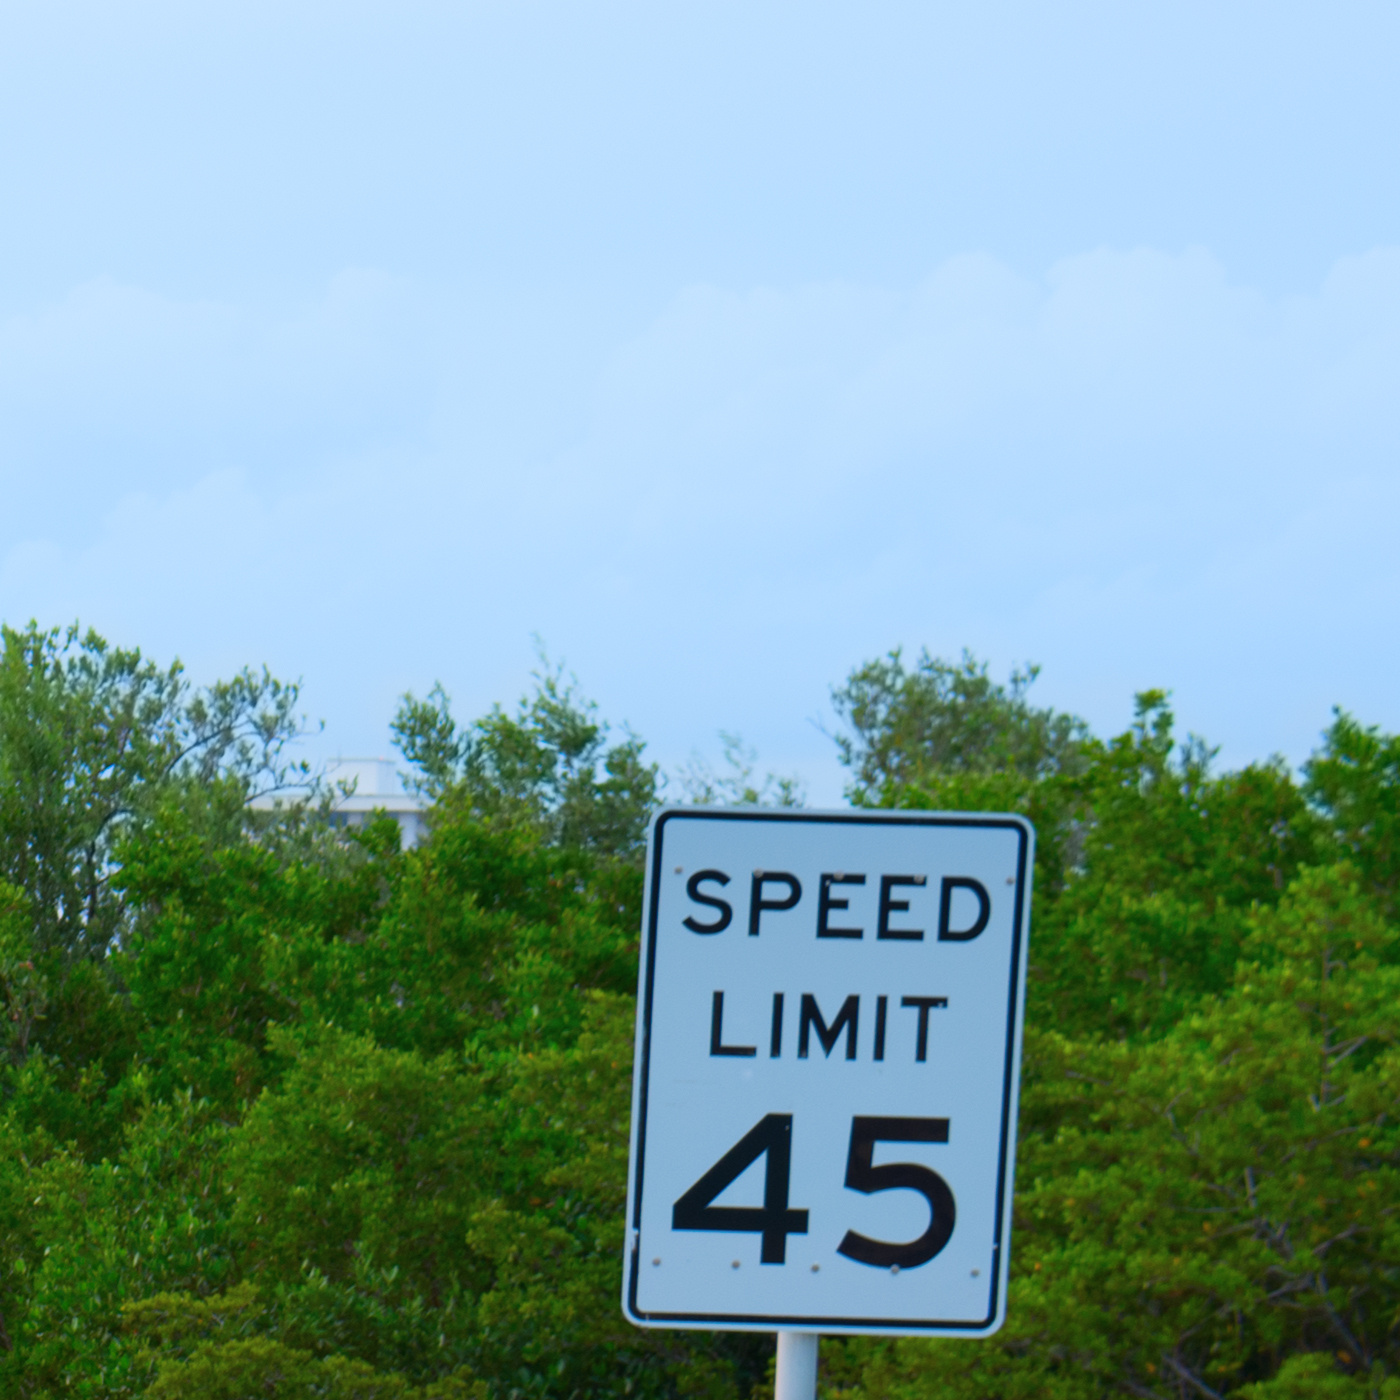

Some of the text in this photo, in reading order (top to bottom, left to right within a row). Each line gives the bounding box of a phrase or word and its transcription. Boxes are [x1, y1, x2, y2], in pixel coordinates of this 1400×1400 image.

[682, 869, 991, 942] SPEED
[709, 990, 949, 1062] LIMIT
[671, 1112, 957, 1269] 45
